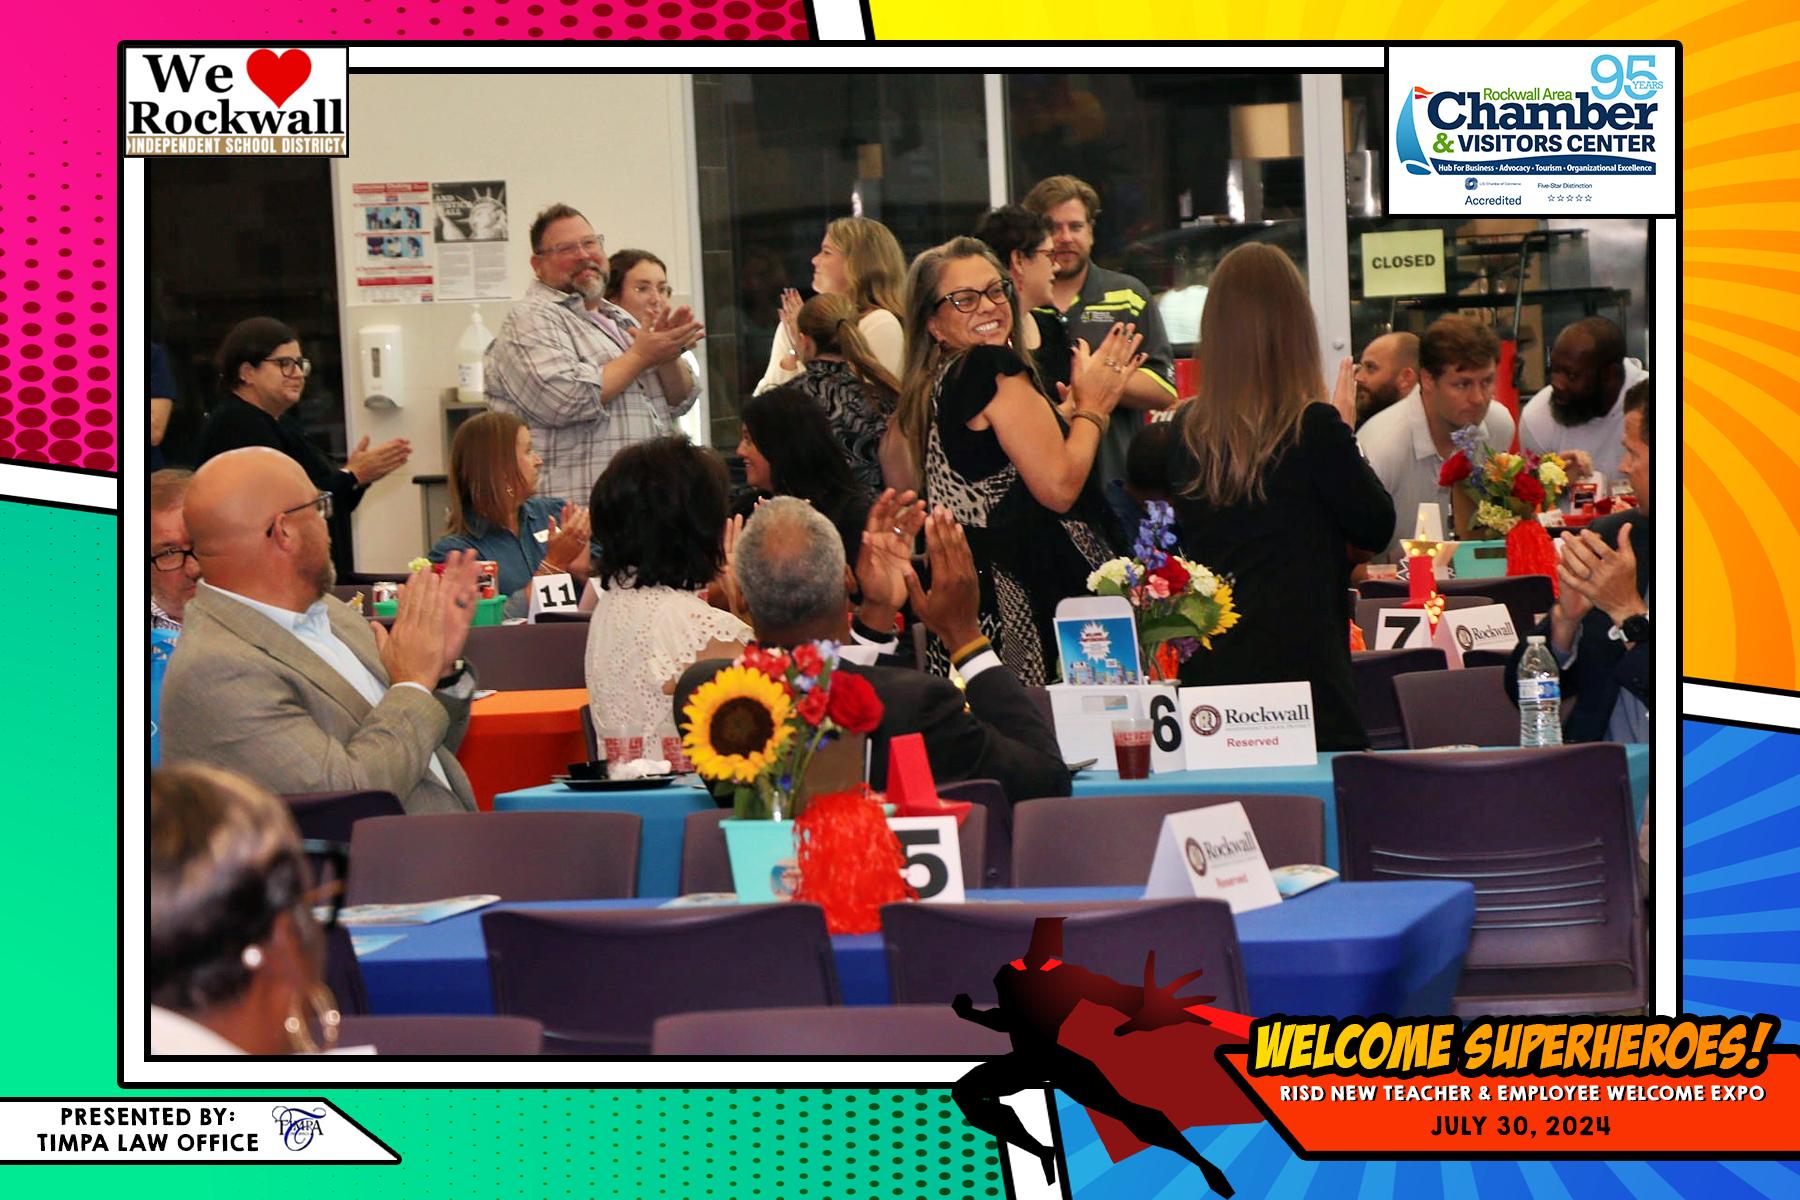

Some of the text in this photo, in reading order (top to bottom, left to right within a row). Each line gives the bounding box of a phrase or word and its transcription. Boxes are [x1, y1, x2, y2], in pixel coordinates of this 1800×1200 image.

[1371, 253, 1436, 270] CLOSED
[540, 583, 576, 607] 11
[1384, 615, 1422, 649] 7
[1471, 623, 1514, 640] Rockwall
[1150, 694, 1182, 752] 6
[1225, 704, 1310, 724] Rockwall
[1226, 735, 1280, 749] Reserved
[1204, 832, 1256, 860] Rockwall
[894, 828, 949, 900] 5
